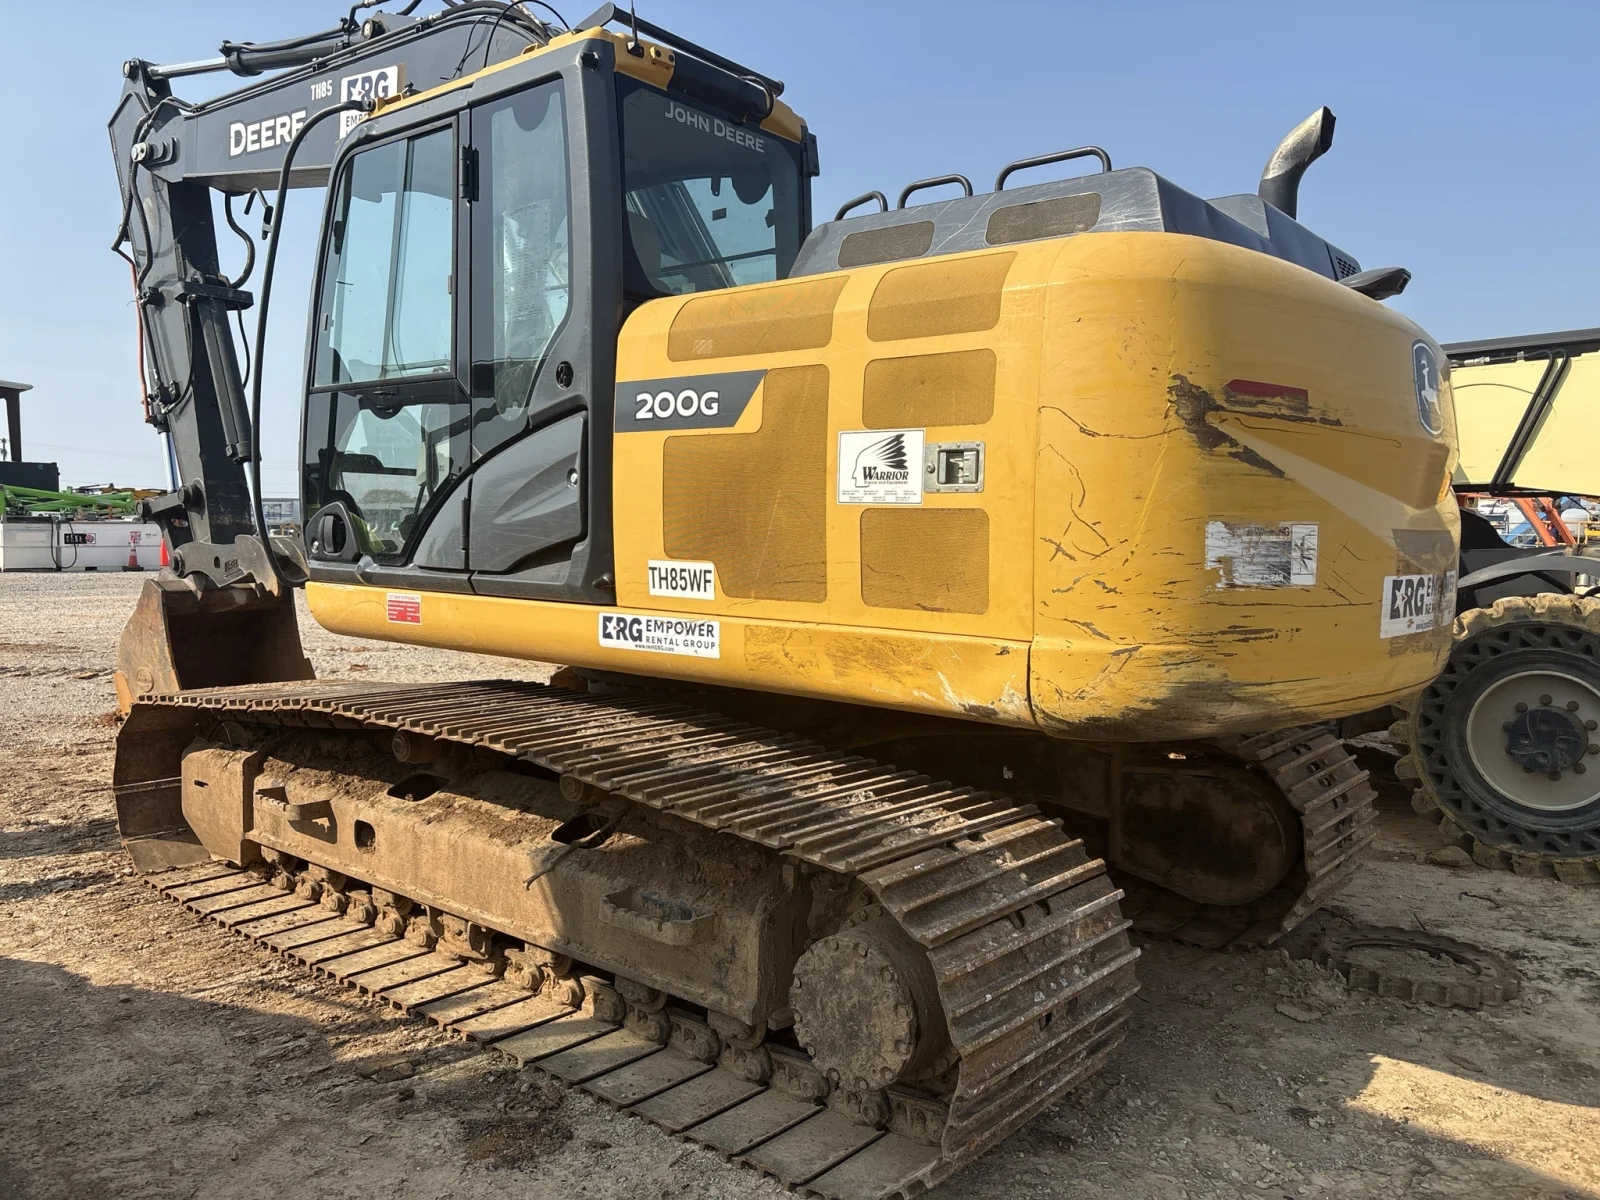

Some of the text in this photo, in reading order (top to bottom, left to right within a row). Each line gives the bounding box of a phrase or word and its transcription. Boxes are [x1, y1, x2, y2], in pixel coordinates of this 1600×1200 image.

[311, 80, 333, 101] TH85
[664, 101, 765, 153] JOHN DEERE
[635, 389, 719, 419] 200G
[648, 566, 713, 593] TH85WF
[1389, 576, 1426, 620] ERG
[602, 615, 643, 643] ERG
[645, 619, 715, 638] EMPOWER
[645, 636, 716, 650] RENTAL GROUP
